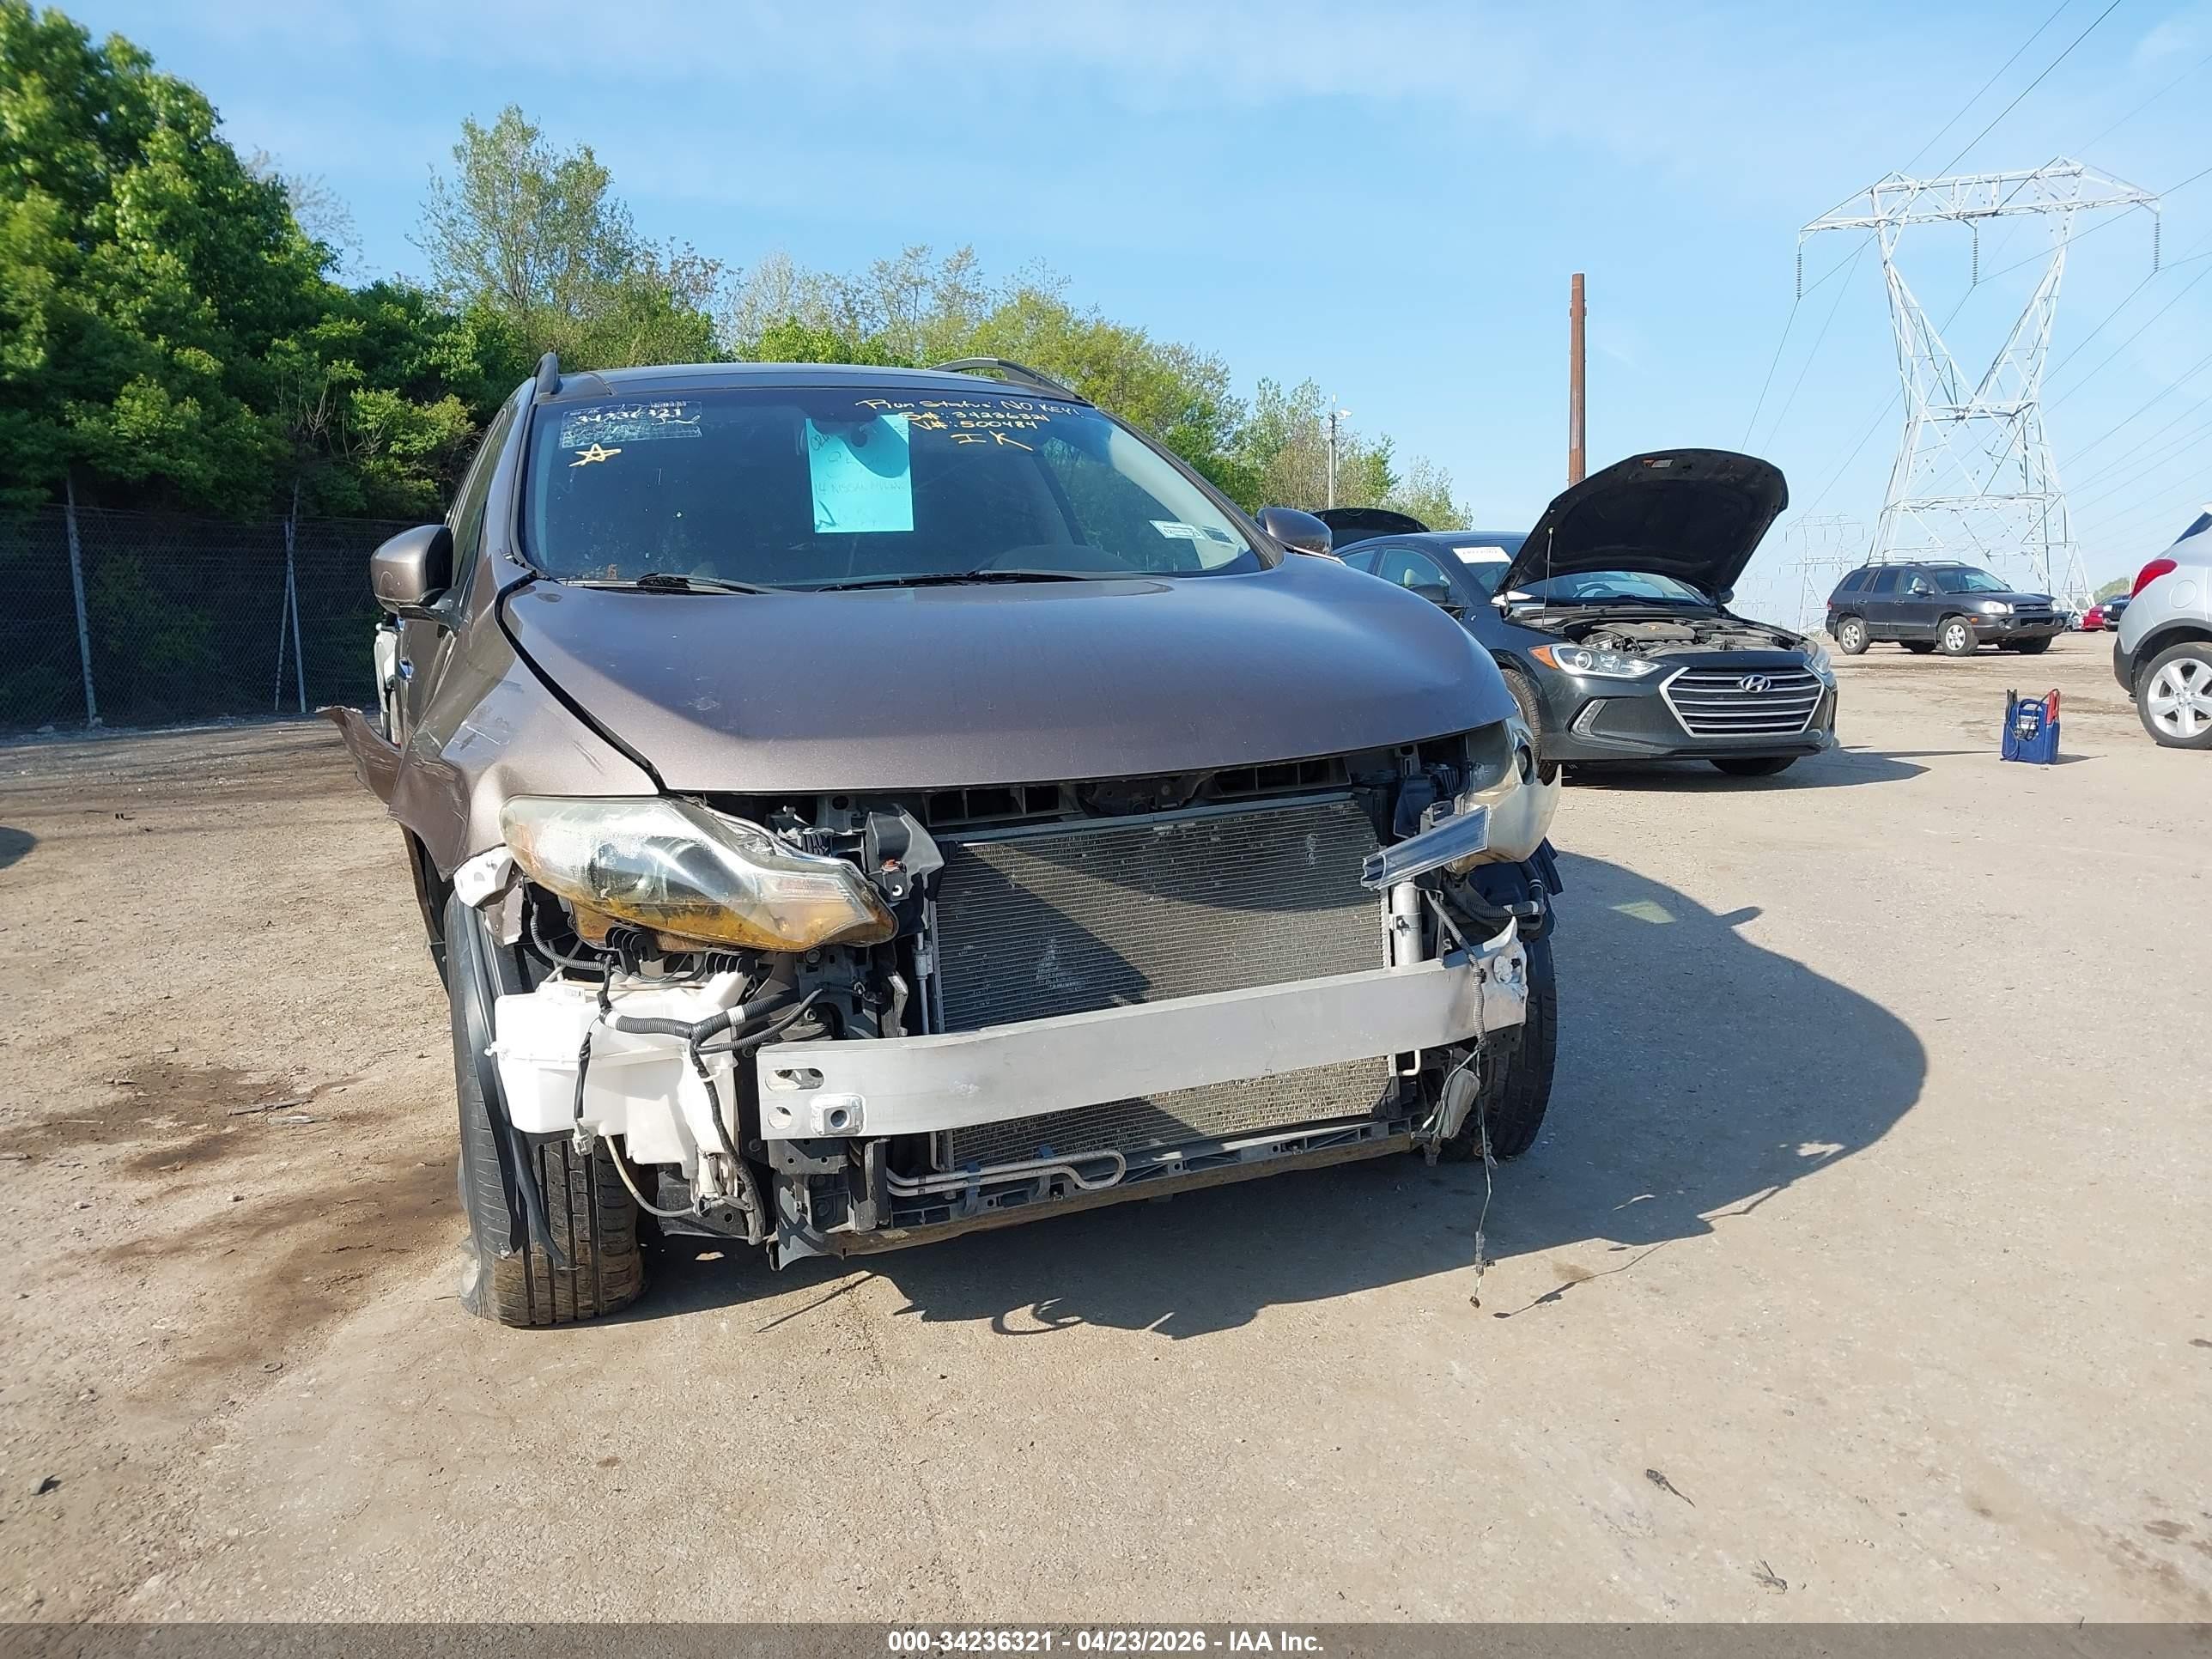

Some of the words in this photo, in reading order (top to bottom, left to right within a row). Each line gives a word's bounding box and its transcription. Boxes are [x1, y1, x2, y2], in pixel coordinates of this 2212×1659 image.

[855, 398, 914, 410] Run
[1000, 400, 1033, 412] NO
[1038, 403, 1085, 418] KEY!
[951, 412, 1050, 422] 34236321
[959, 421, 1038, 429] 500484
